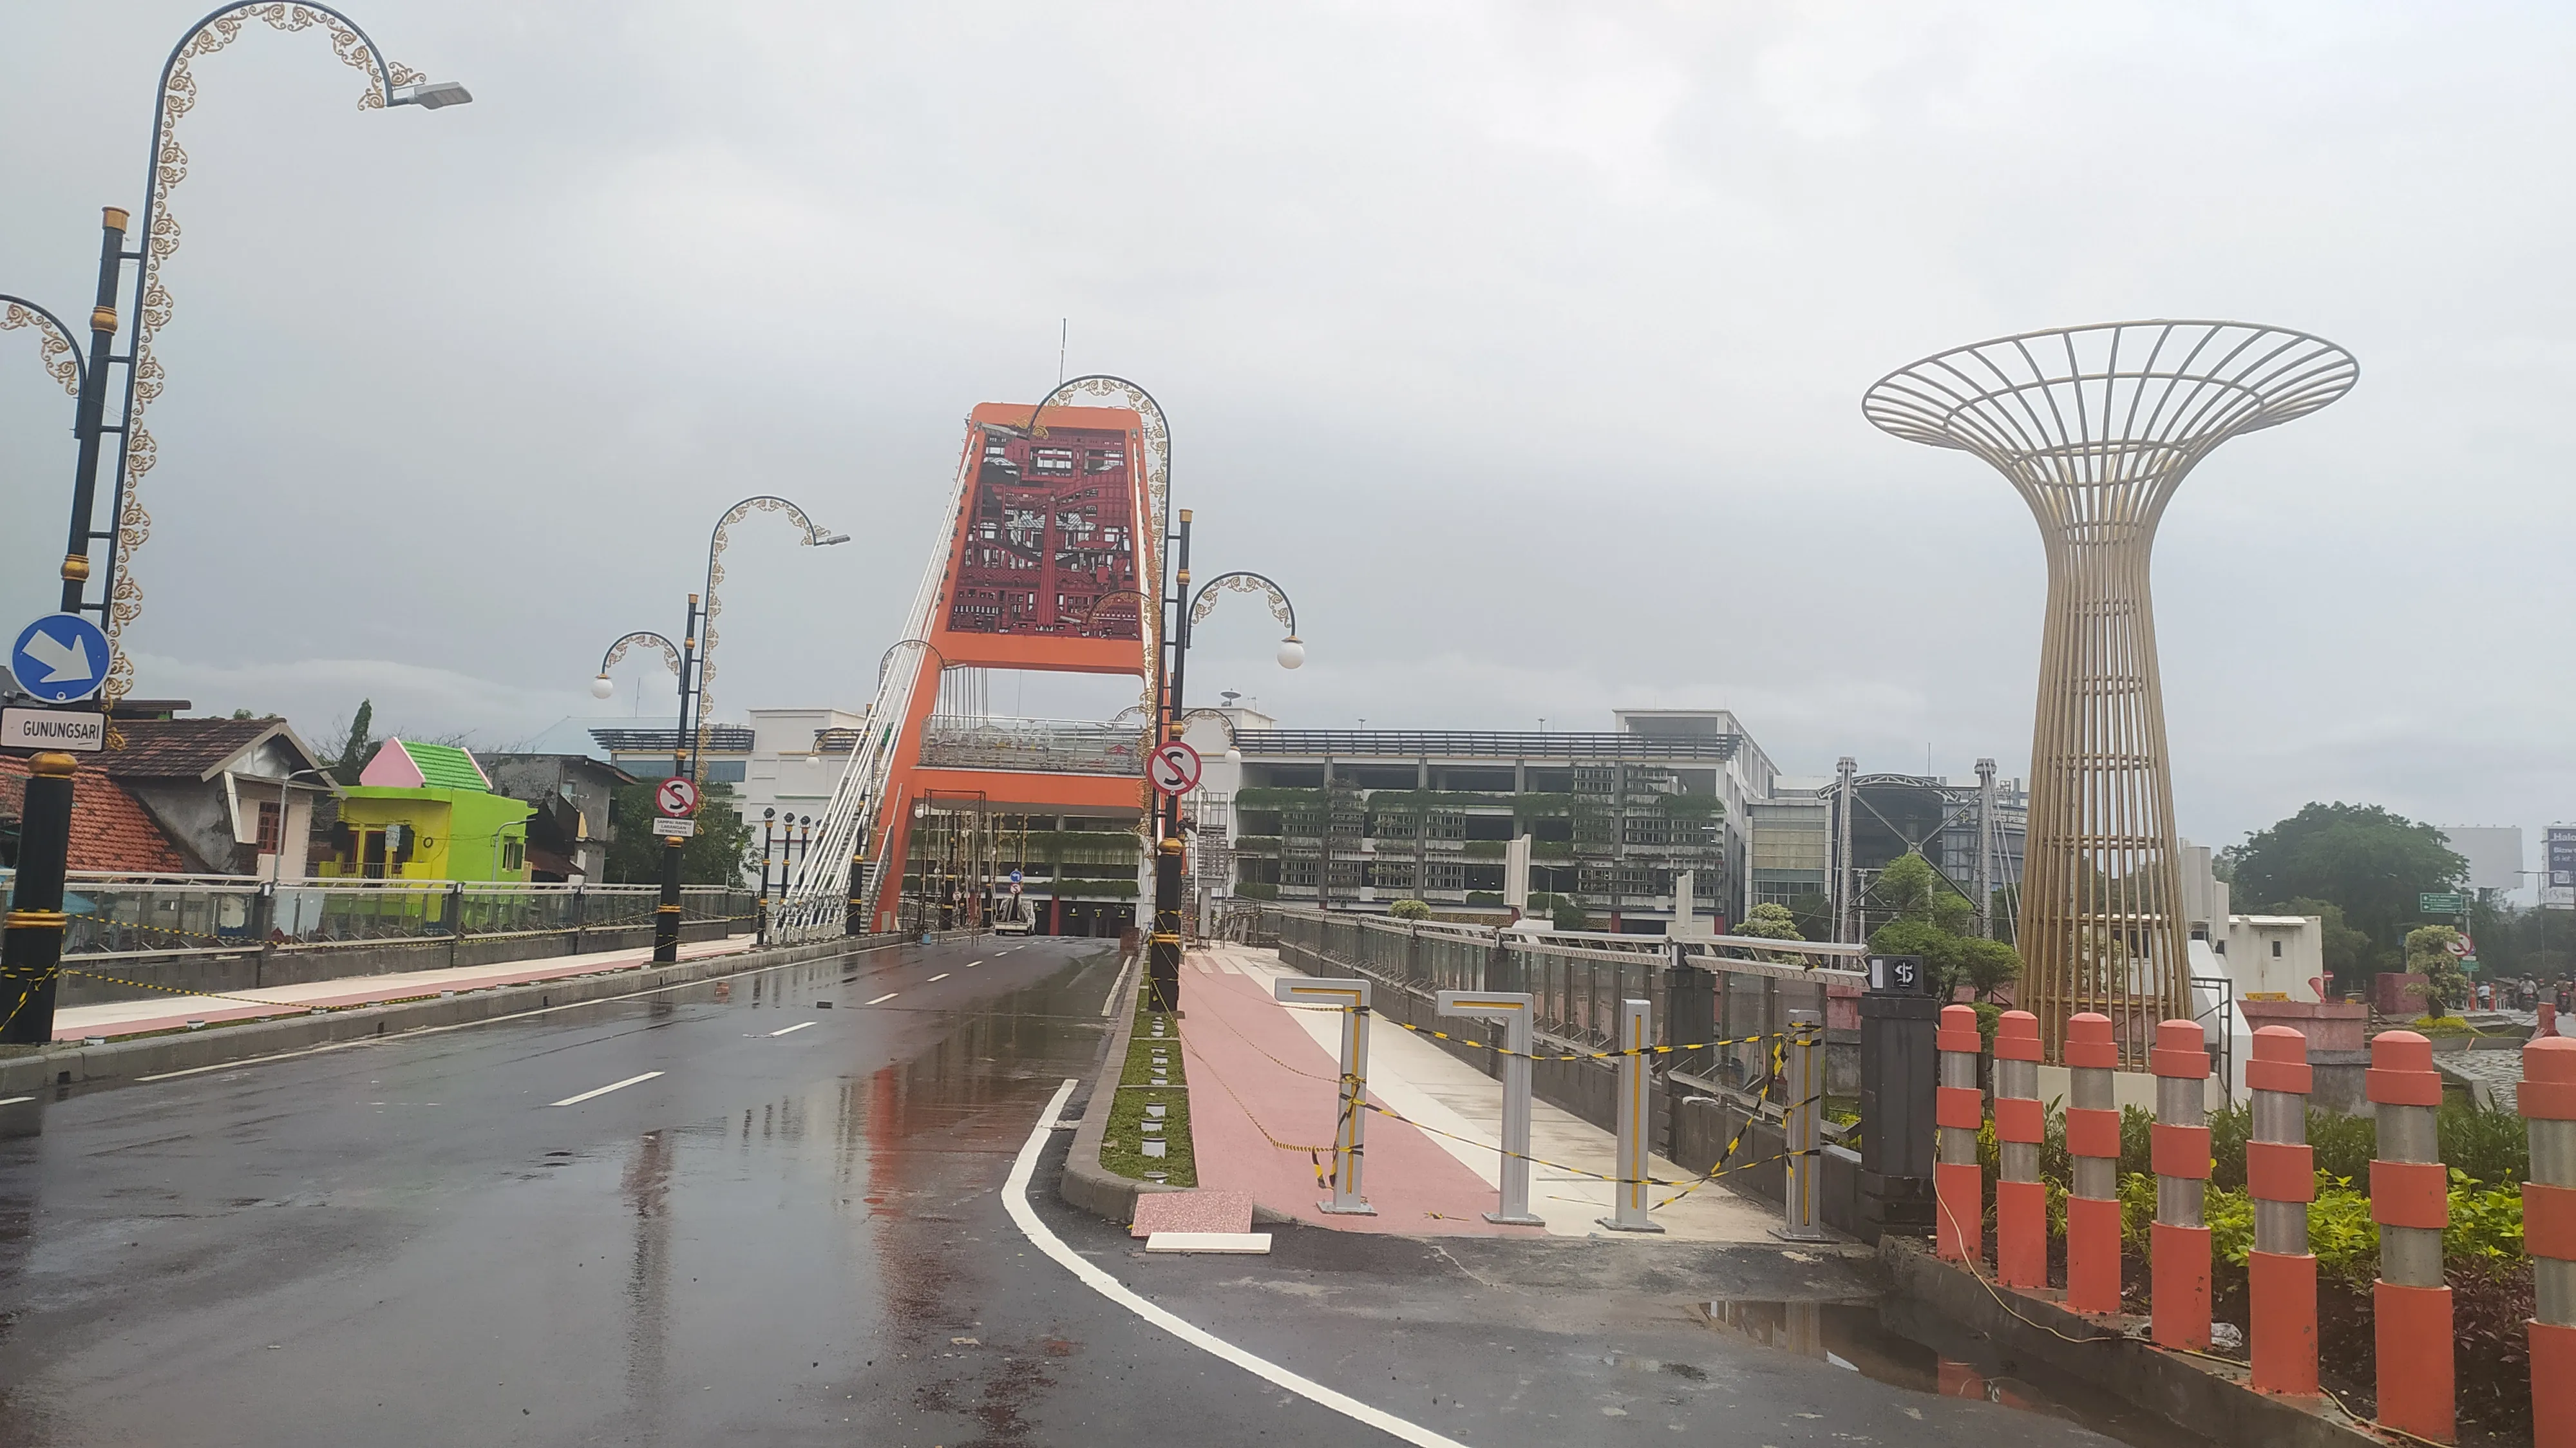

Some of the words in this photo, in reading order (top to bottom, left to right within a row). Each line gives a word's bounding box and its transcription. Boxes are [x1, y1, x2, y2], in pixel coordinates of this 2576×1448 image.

[23, 720, 100, 740] GUNUNGSARI
[1163, 751, 1184, 786] S
[669, 784, 684, 810] S
